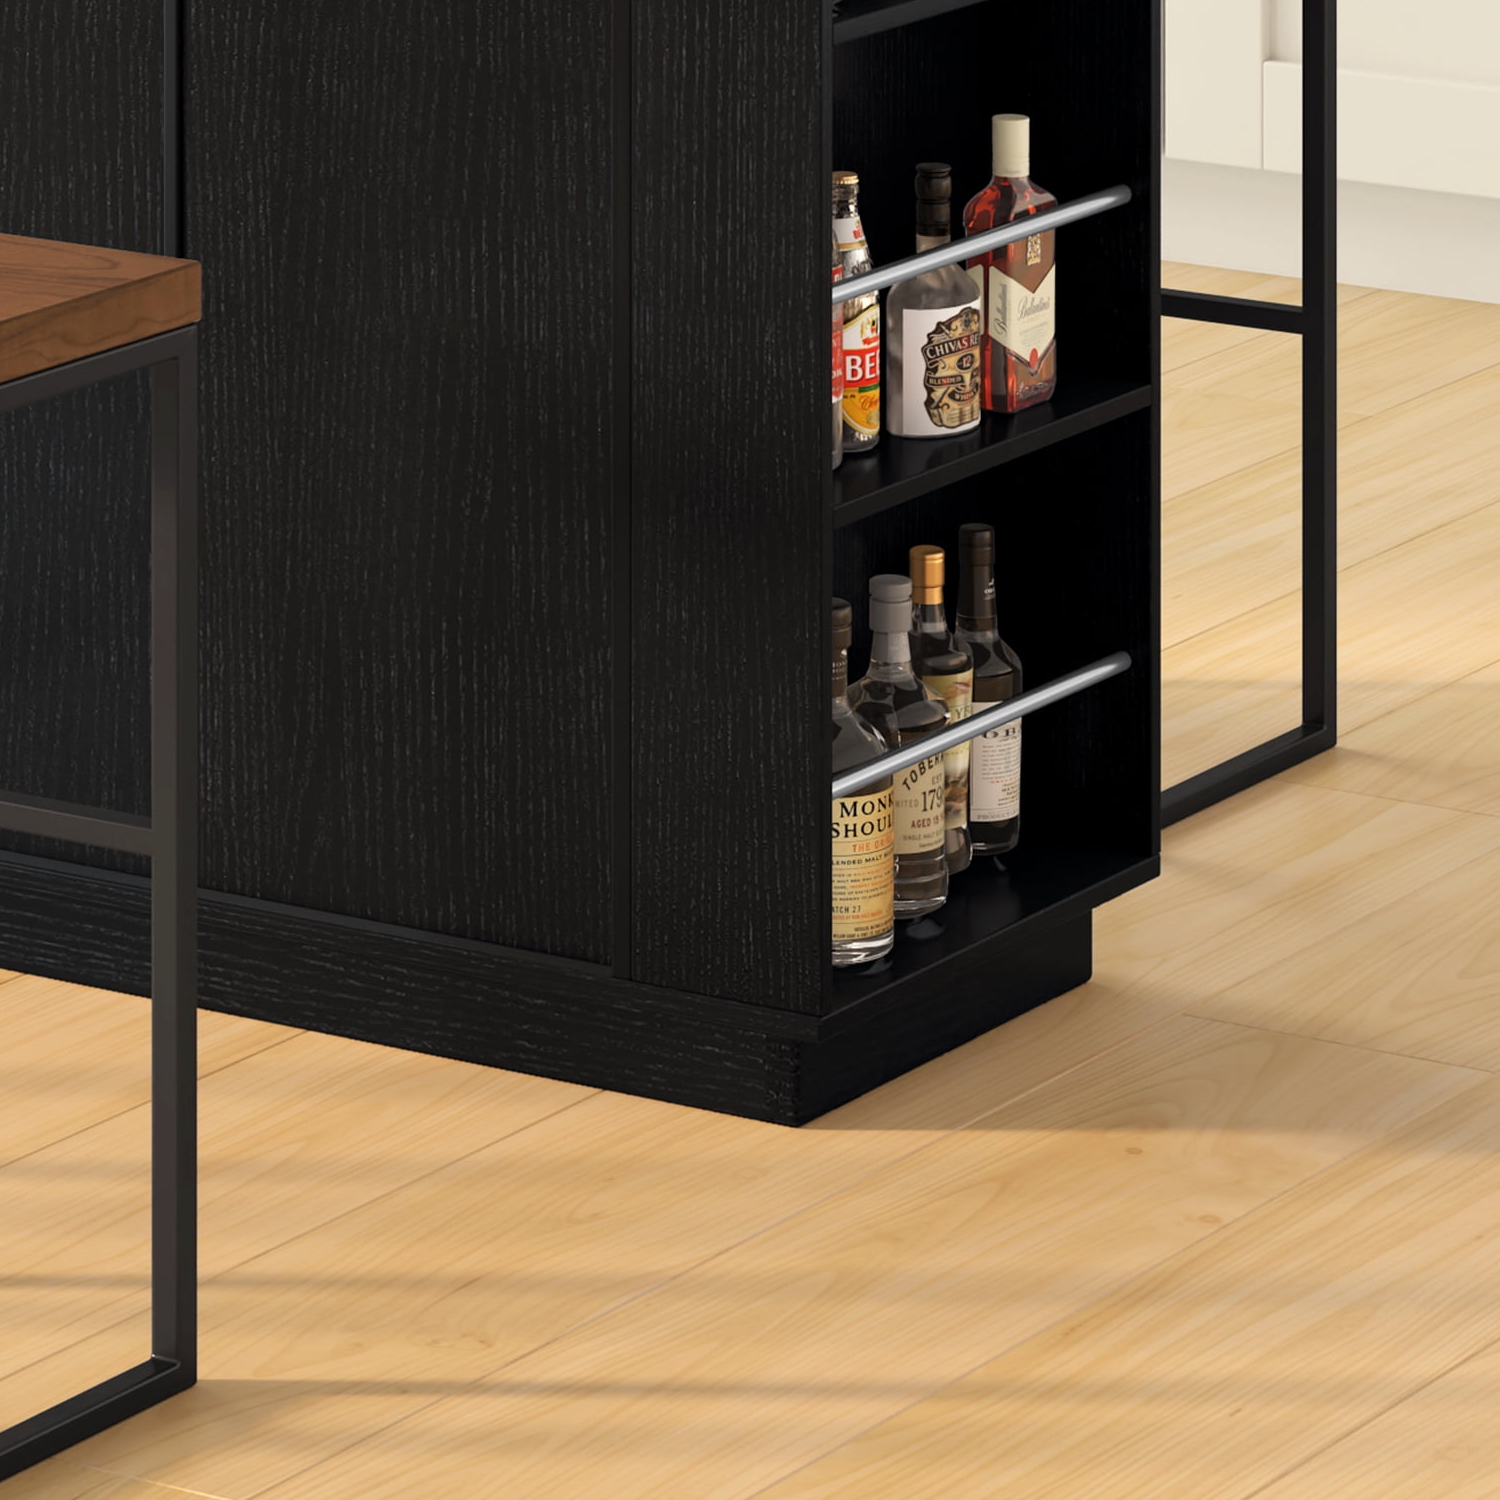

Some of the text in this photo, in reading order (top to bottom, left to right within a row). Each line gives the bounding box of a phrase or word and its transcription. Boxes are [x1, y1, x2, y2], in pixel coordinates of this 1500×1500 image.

[926, 337, 969, 359] CHIVAS
[911, 818, 931, 829] AGED
[852, 842, 870, 852] THE
